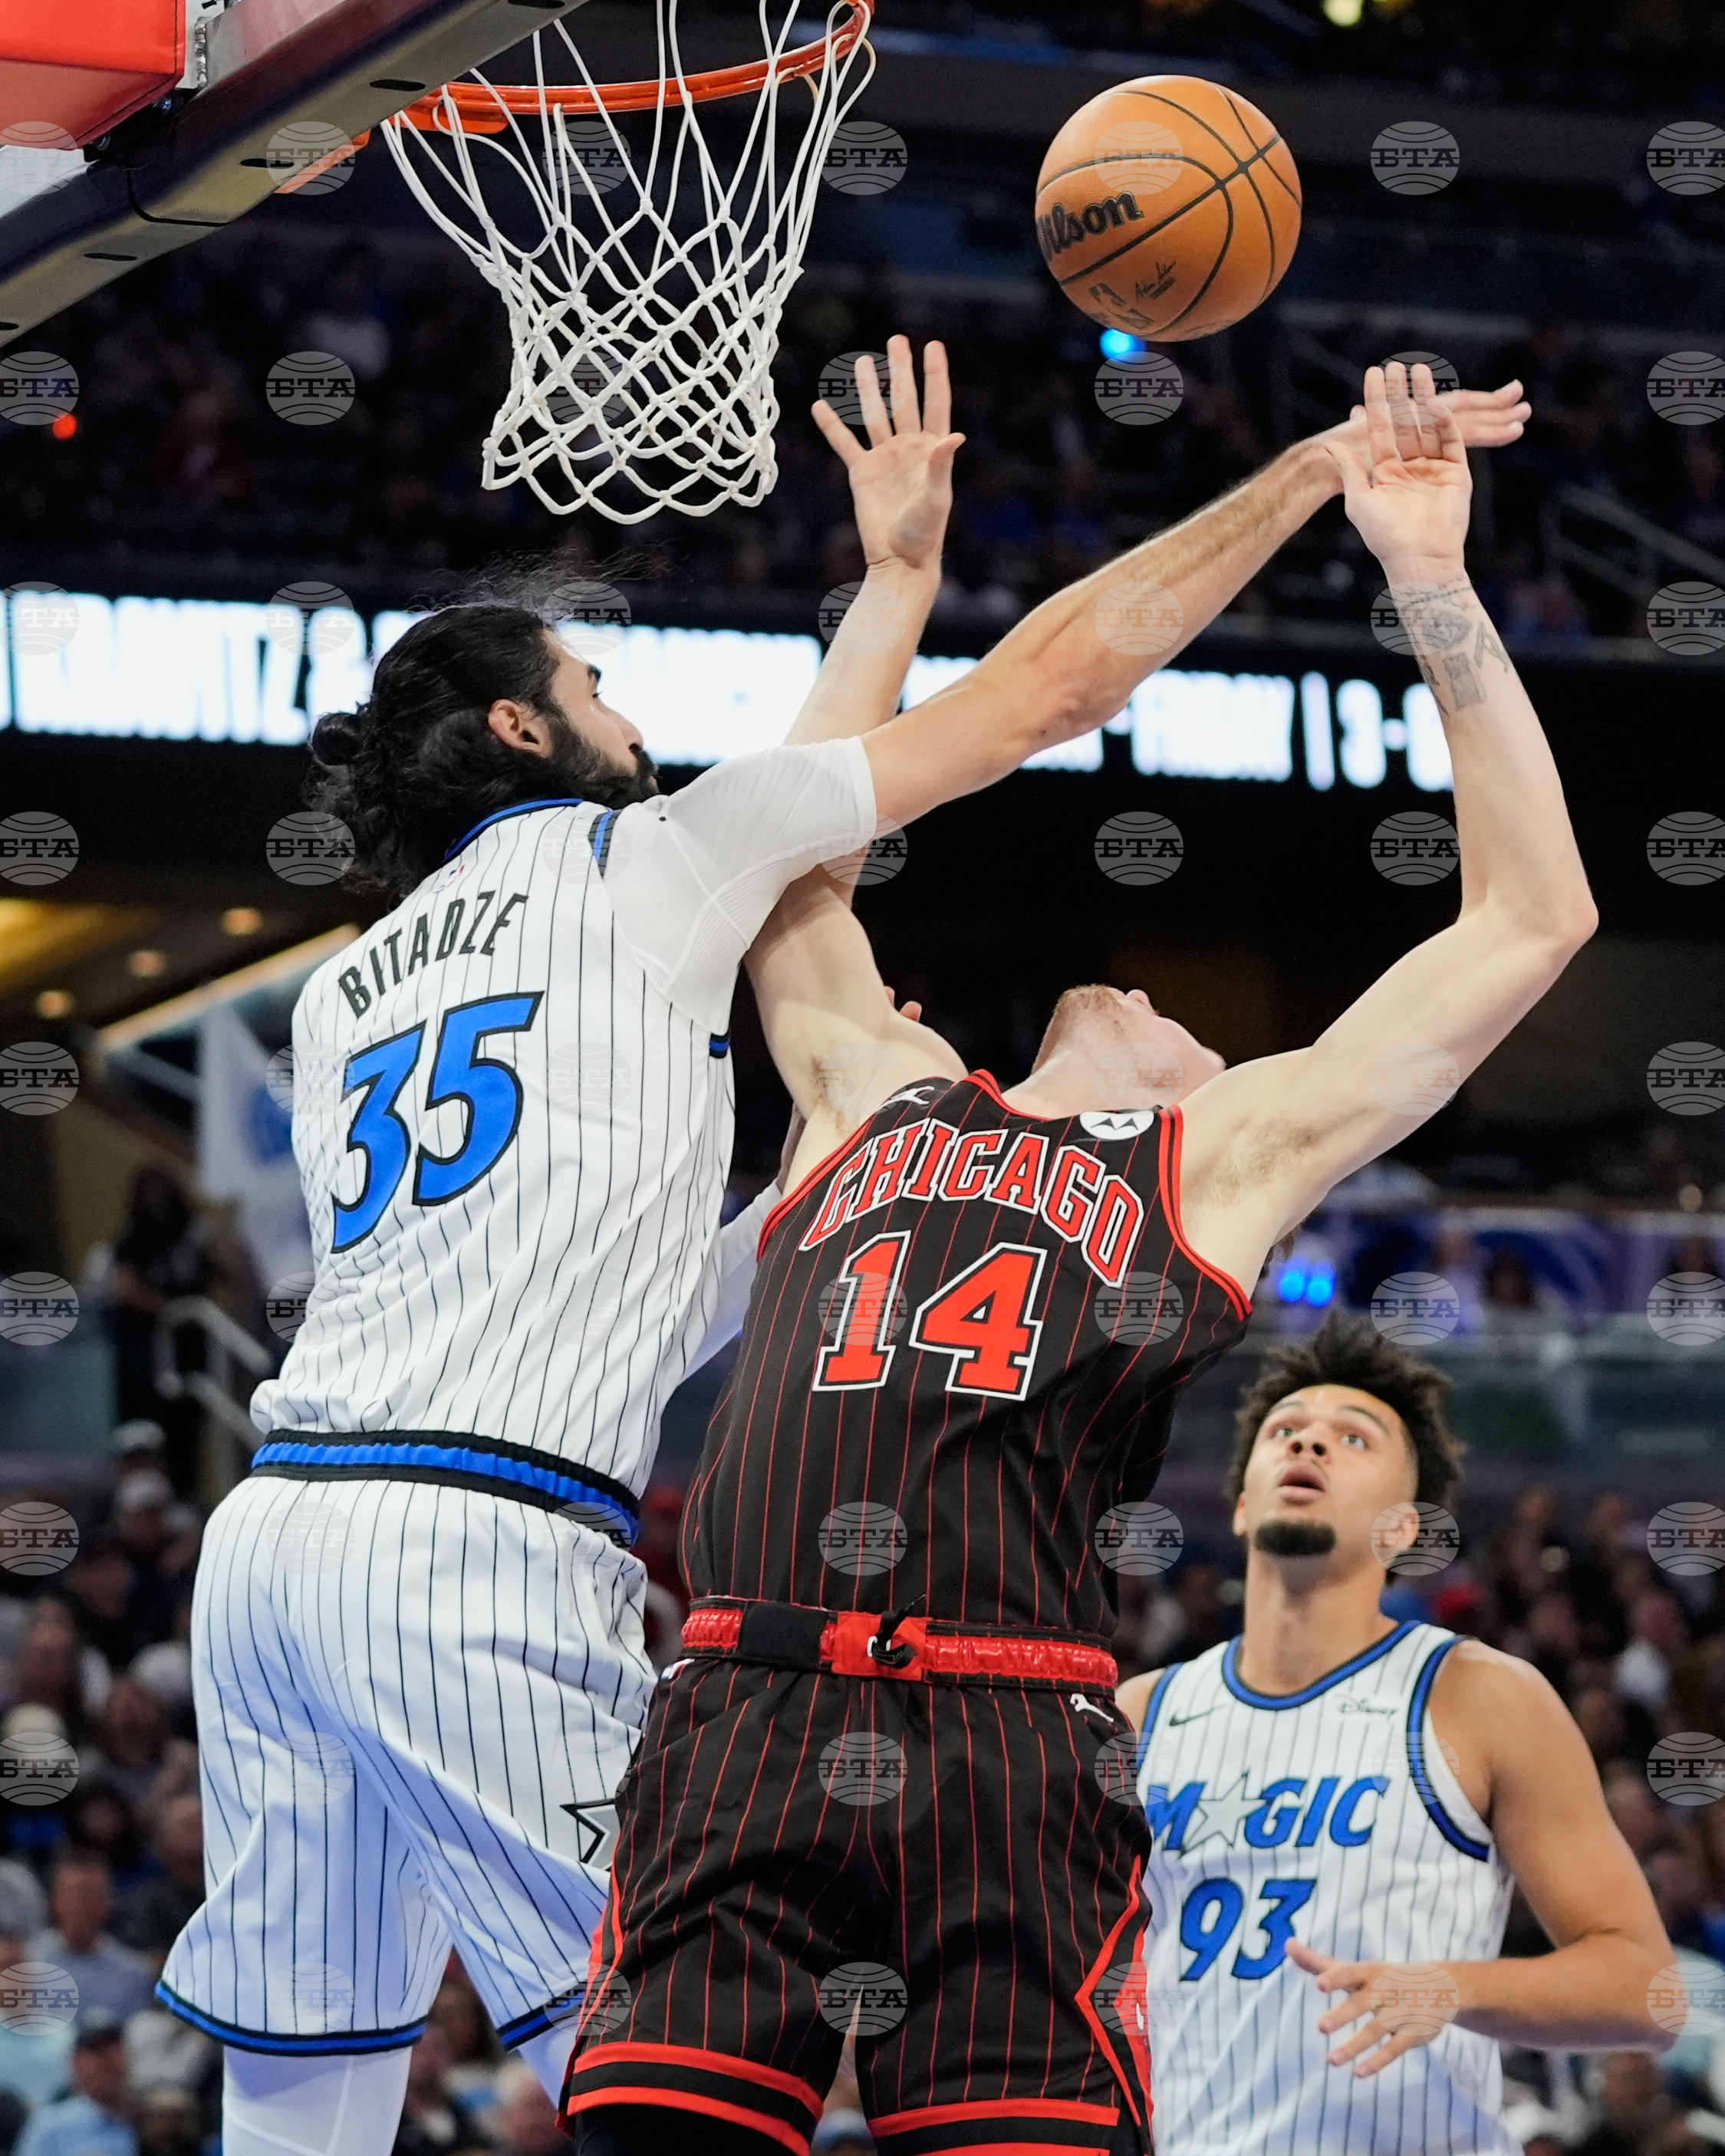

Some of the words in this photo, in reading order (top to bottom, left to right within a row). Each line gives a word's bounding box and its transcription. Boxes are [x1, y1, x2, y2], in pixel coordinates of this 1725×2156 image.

[337, 890, 528, 1019] BITADZE
[331, 991, 545, 1253] 35
[798, 1117, 1144, 1287] CHICAGO
[812, 1229, 1047, 1401] 14
[1180, 1878, 1316, 1982] 93
